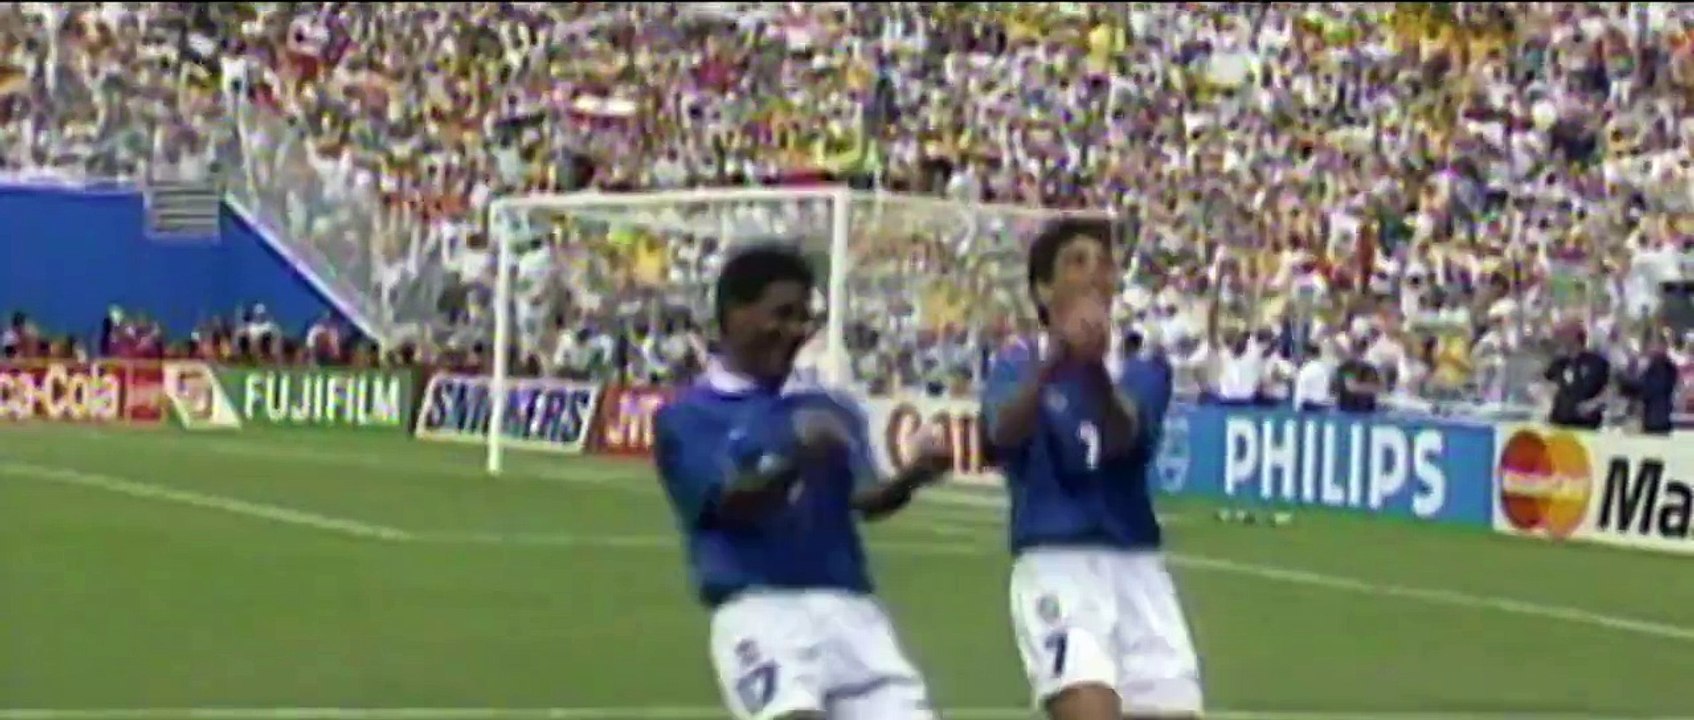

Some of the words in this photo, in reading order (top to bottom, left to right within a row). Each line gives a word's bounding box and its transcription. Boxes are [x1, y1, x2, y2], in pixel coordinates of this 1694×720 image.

[244, 374, 400, 425] FUJIFILM
[1224, 416, 1447, 518] PHILIPS
[1597, 456, 1694, 538] Ma
